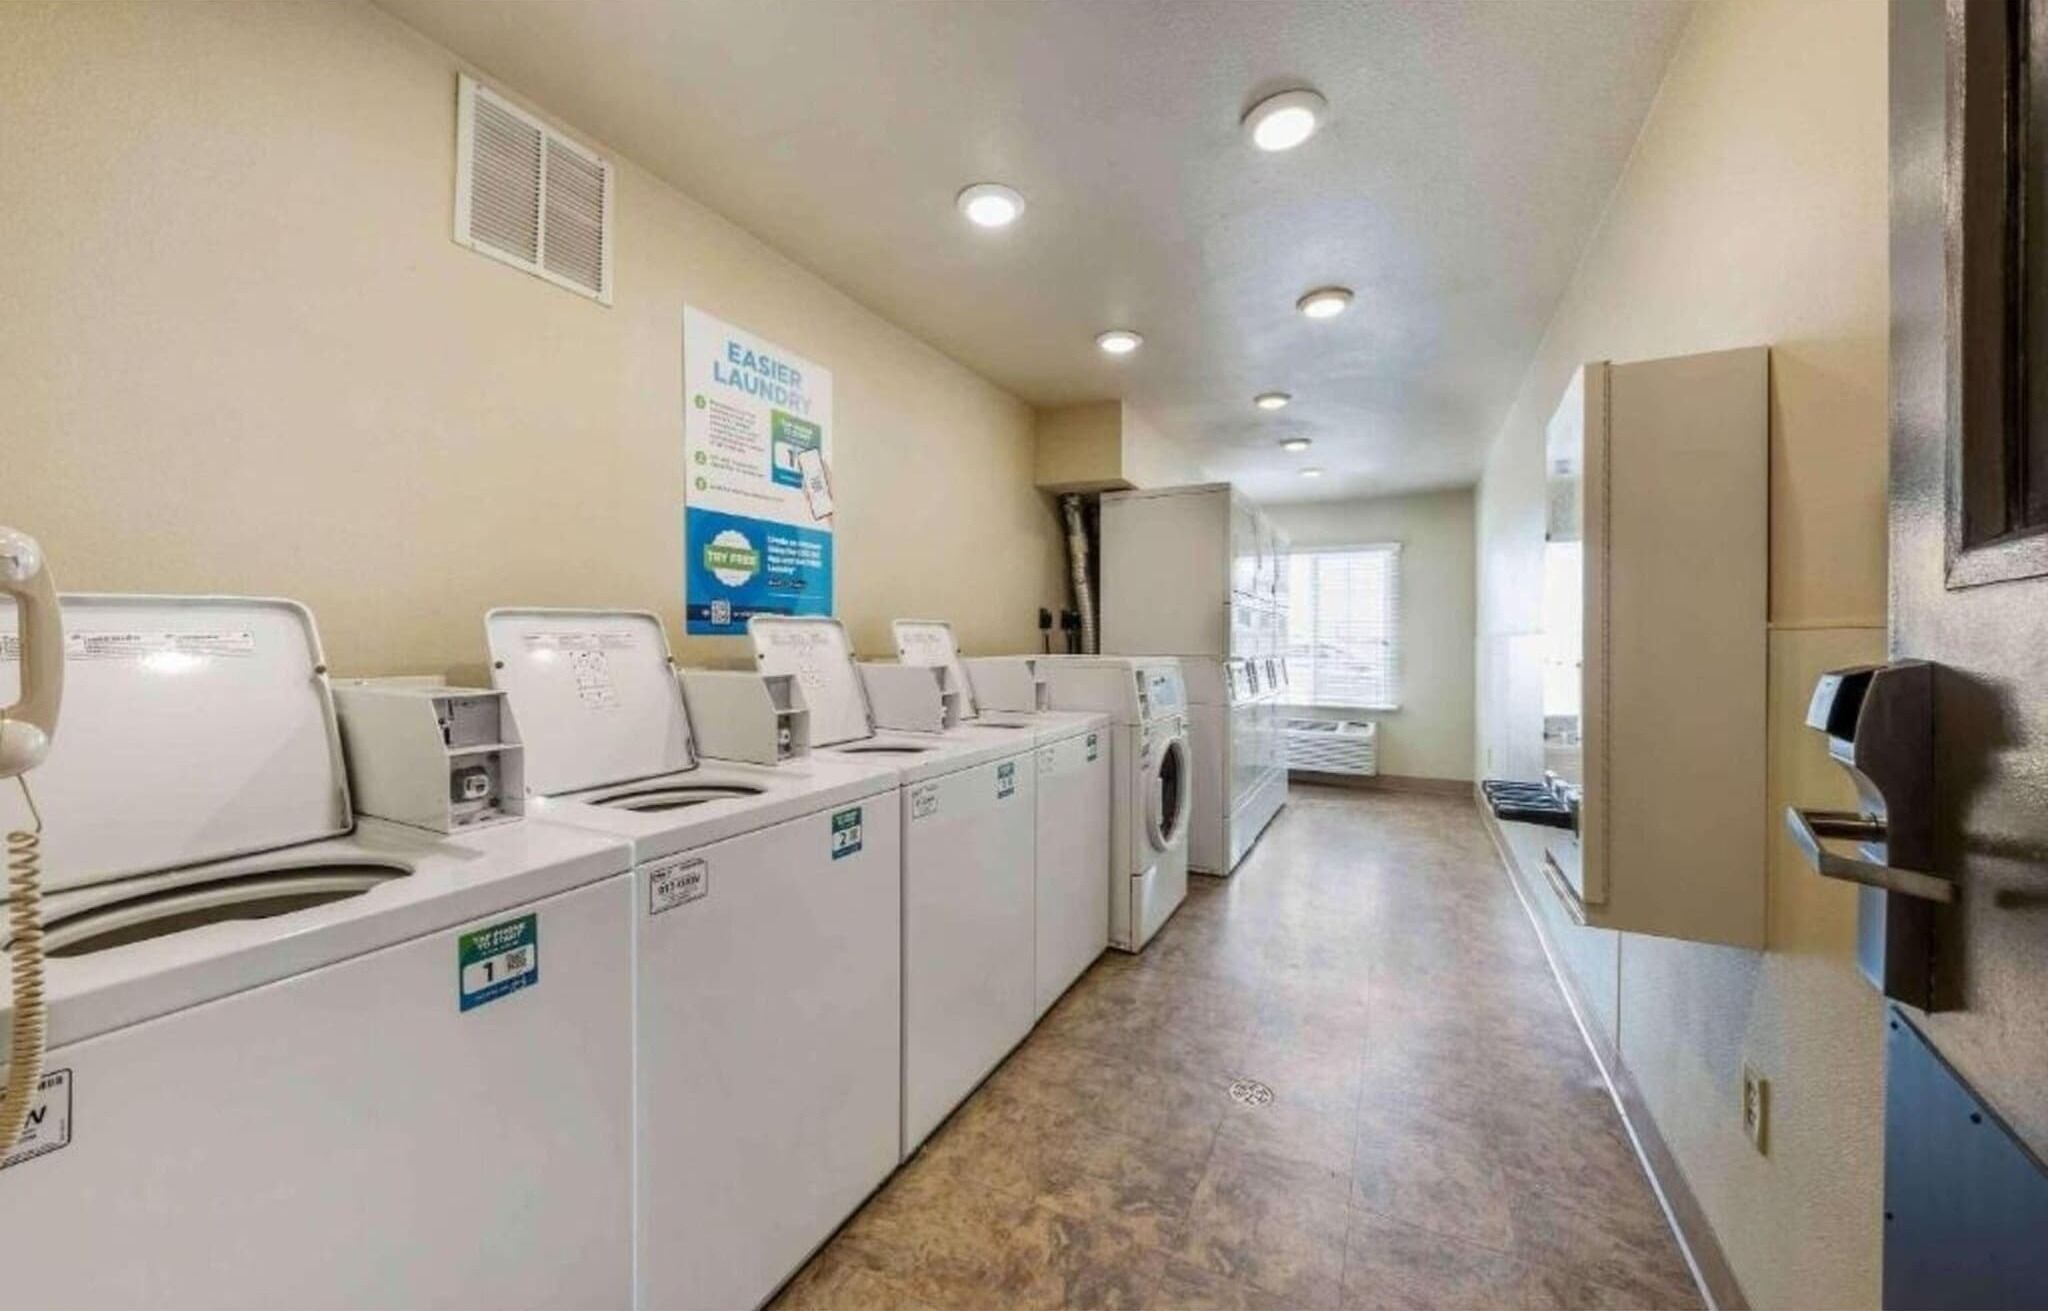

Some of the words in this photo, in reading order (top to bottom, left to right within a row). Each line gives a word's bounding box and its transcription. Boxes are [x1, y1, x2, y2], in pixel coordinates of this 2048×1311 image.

[728, 341, 801, 389] EASIER
[714, 361, 811, 415] LAUNDRY
[706, 550, 728, 563] TRY
[729, 553, 757, 567] FREE
[483, 962, 493, 981] 1
